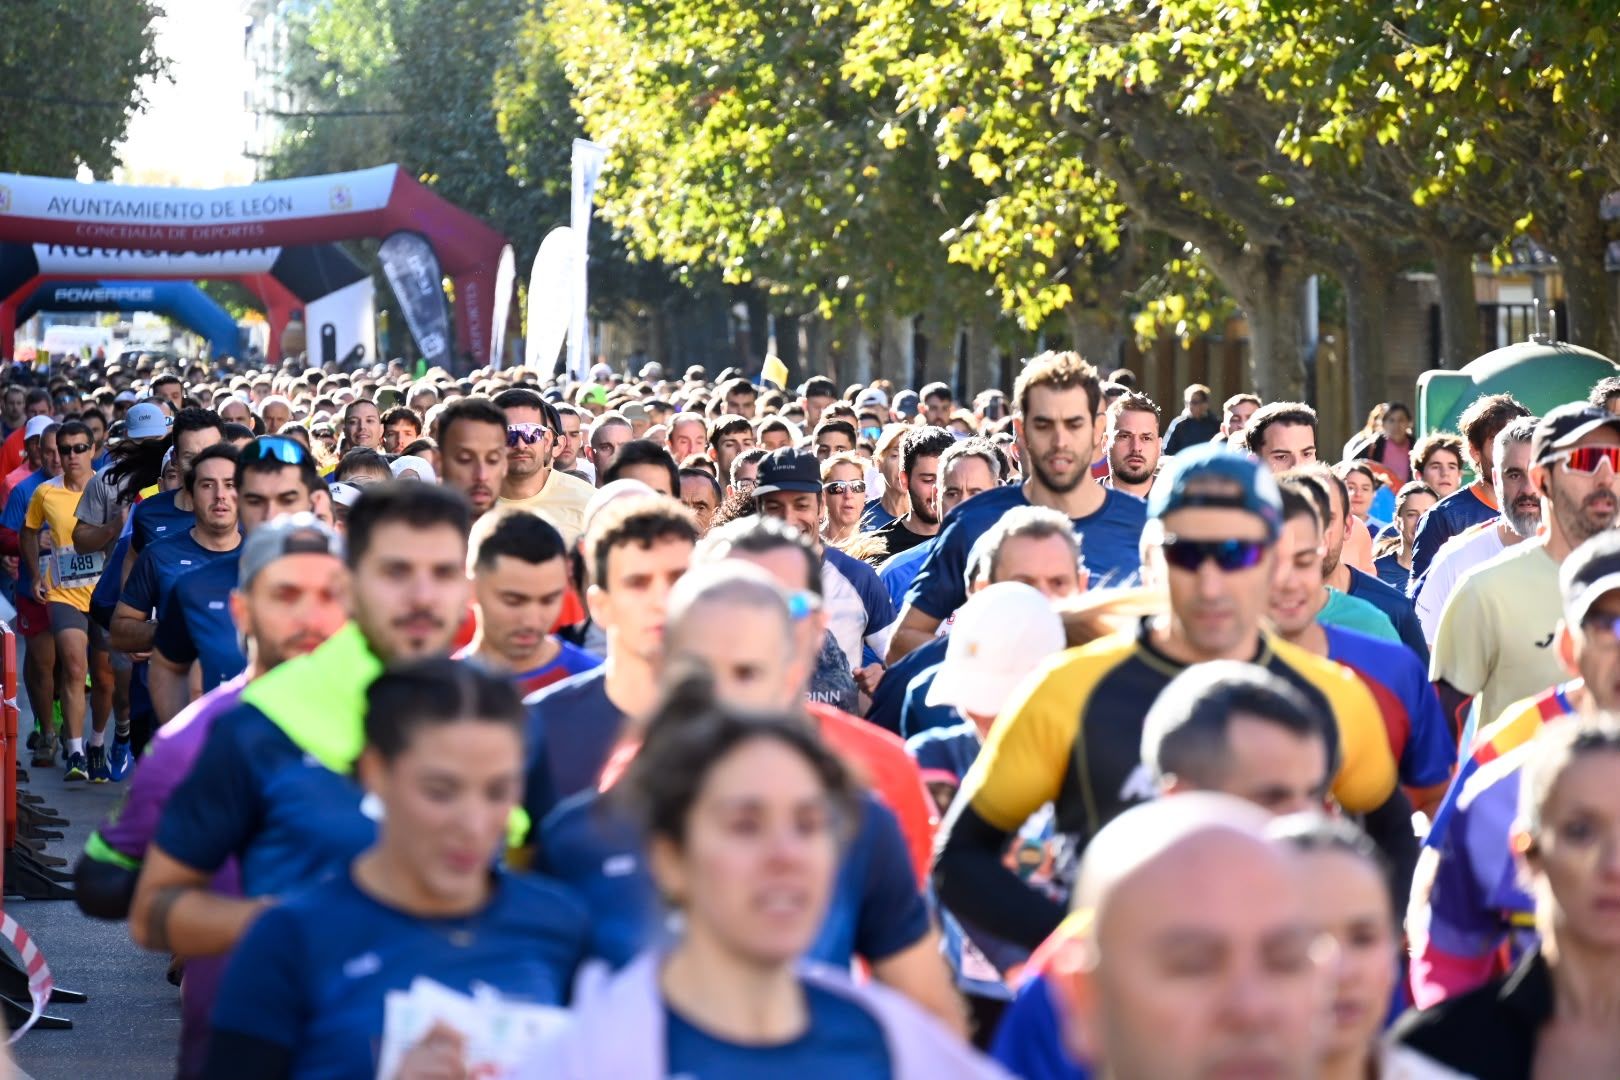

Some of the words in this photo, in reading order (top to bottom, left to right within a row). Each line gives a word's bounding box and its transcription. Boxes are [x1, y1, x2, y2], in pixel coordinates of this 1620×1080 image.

[47, 196, 204, 220] AYUNTAMIENTO
[210, 201, 235, 217] DE
[242, 193, 294, 216] LEÓN
[168, 226, 188, 240] DE
[192, 223, 265, 240] DEPORTES
[55, 287, 154, 302] POWERADE
[70, 554, 94, 571] 489
